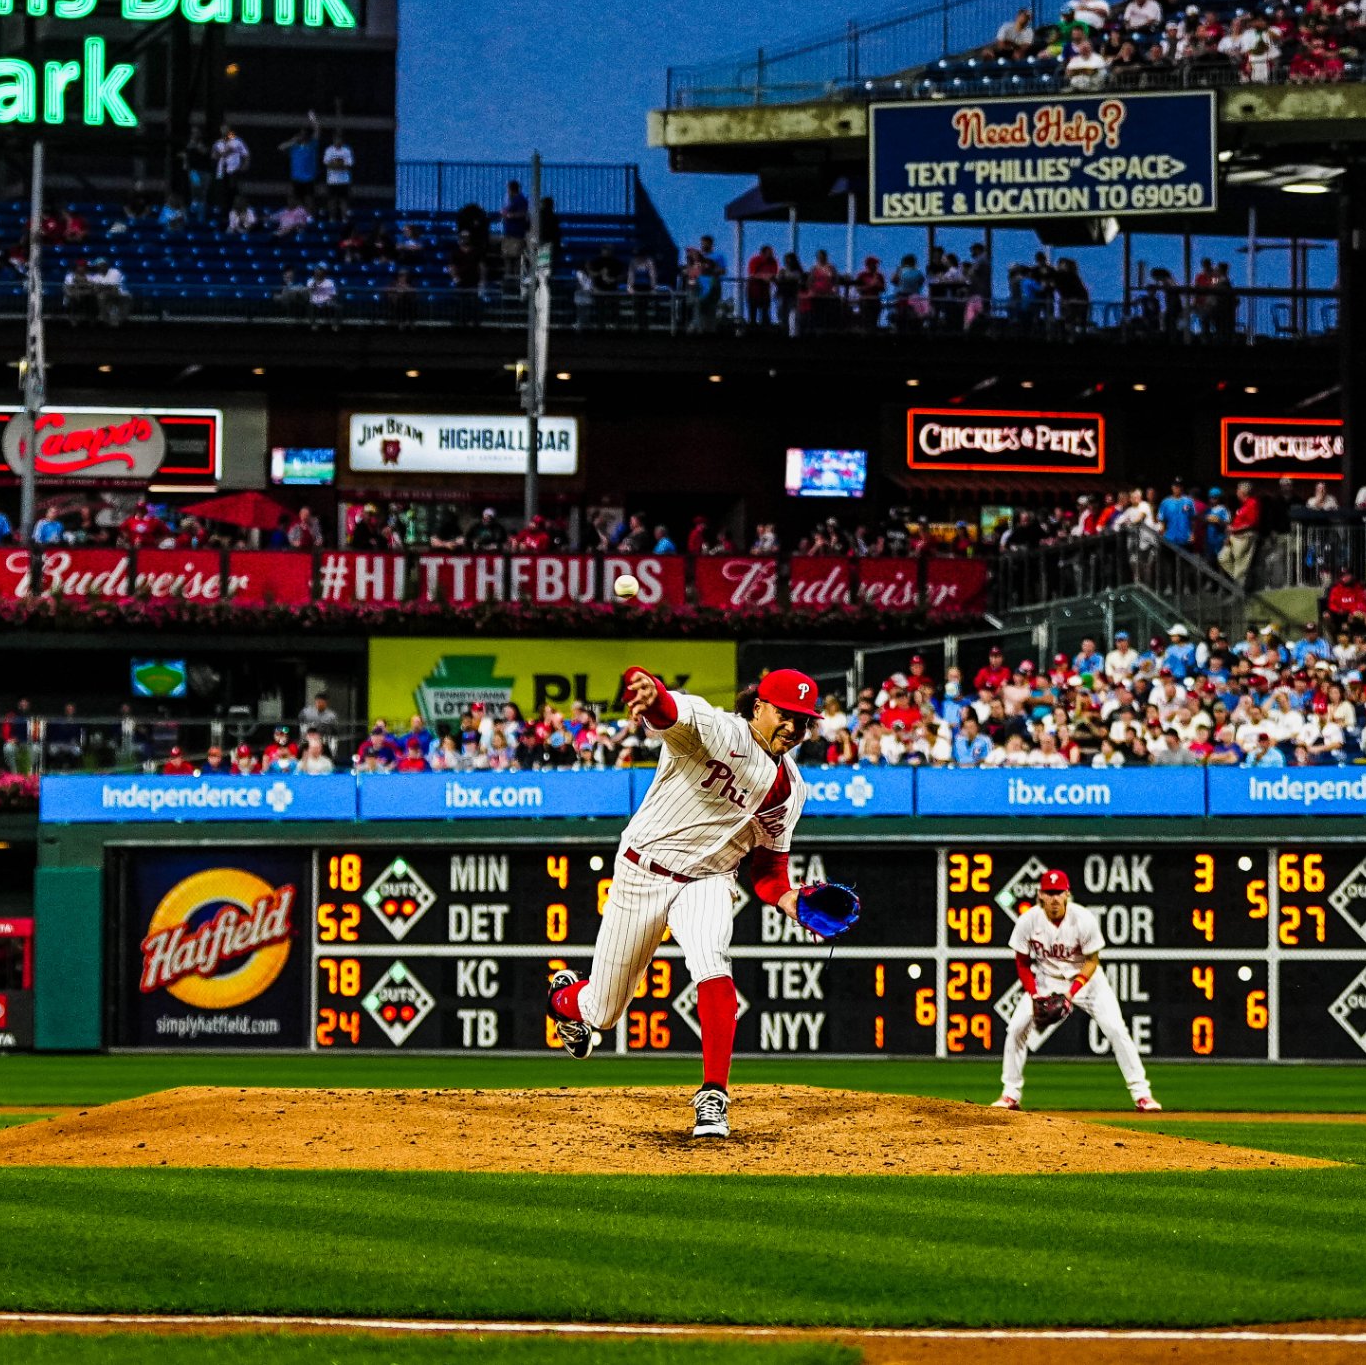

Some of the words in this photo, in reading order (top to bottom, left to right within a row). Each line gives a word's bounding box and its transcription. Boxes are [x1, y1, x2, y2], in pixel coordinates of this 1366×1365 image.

[952, 108, 1029, 149] Need
[1034, 99, 1126, 156] Help?
[904, 162, 958, 186] TEXT
[1083, 154, 1187, 181] <SPACE>
[883, 193, 944, 217] ISSUE
[952, 194, 968, 214] &
[975, 189, 1089, 215] LOCATION
[1095, 185, 1127, 210] TO
[1131, 183, 1204, 208] 69050
[357, 422, 383, 446] JIM
[387, 418, 423, 445] BEAM
[438, 428, 527, 452] HIGHBALL
[534, 430, 570, 451] BAR
[919, 422, 1020, 455] CHICKIE'S
[1021, 426, 1034, 448] &
[1036, 425, 1097, 457] PETE'S
[1234, 431, 1333, 464] CHICKIE'S
[320, 555, 663, 603] #HITTHEBUDS
[102, 783, 261, 813] Independence
[446, 782, 542, 807] ibx.com
[1008, 778, 1110, 805] ibx.com
[329, 854, 361, 892] 18
[450, 855, 509, 892] MIN
[546, 855, 568, 889] 4
[379, 883, 417, 897] OUTS
[787, 855, 828, 890] EA
[949, 854, 992, 892] 32
[1084, 854, 1154, 894] OAK
[1194, 854, 1214, 892] 3
[1278, 853, 1324, 892] 66
[1246, 880, 1268, 918] 5
[143, 887, 294, 990] Hatfield
[317, 903, 361, 941] 52
[448, 905, 509, 942] DET
[546, 903, 568, 942] 0
[947, 905, 992, 944] 40
[1192, 908, 1214, 942] 4
[1279, 906, 1325, 944] 27
[320, 959, 361, 997] 78
[456, 960, 499, 998] KC
[379, 989, 416, 1002] OUTS
[762, 962, 824, 999] TEX
[875, 964, 885, 997] 1
[948, 962, 992, 1001] 20
[1192, 966, 1214, 1000] 4
[156, 1014, 281, 1038] simplyhatfield.com
[915, 988, 936, 1026] 6
[1246, 991, 1268, 1029] 6
[317, 1008, 360, 1045] 24
[457, 1009, 498, 1047] TB
[628, 1011, 671, 1049] 36
[760, 1012, 826, 1051] NYY
[875, 1016, 885, 1048] 1
[947, 1014, 991, 1051] 29
[1089, 1015, 1152, 1054] CE
[1192, 1016, 1214, 1054] 0
